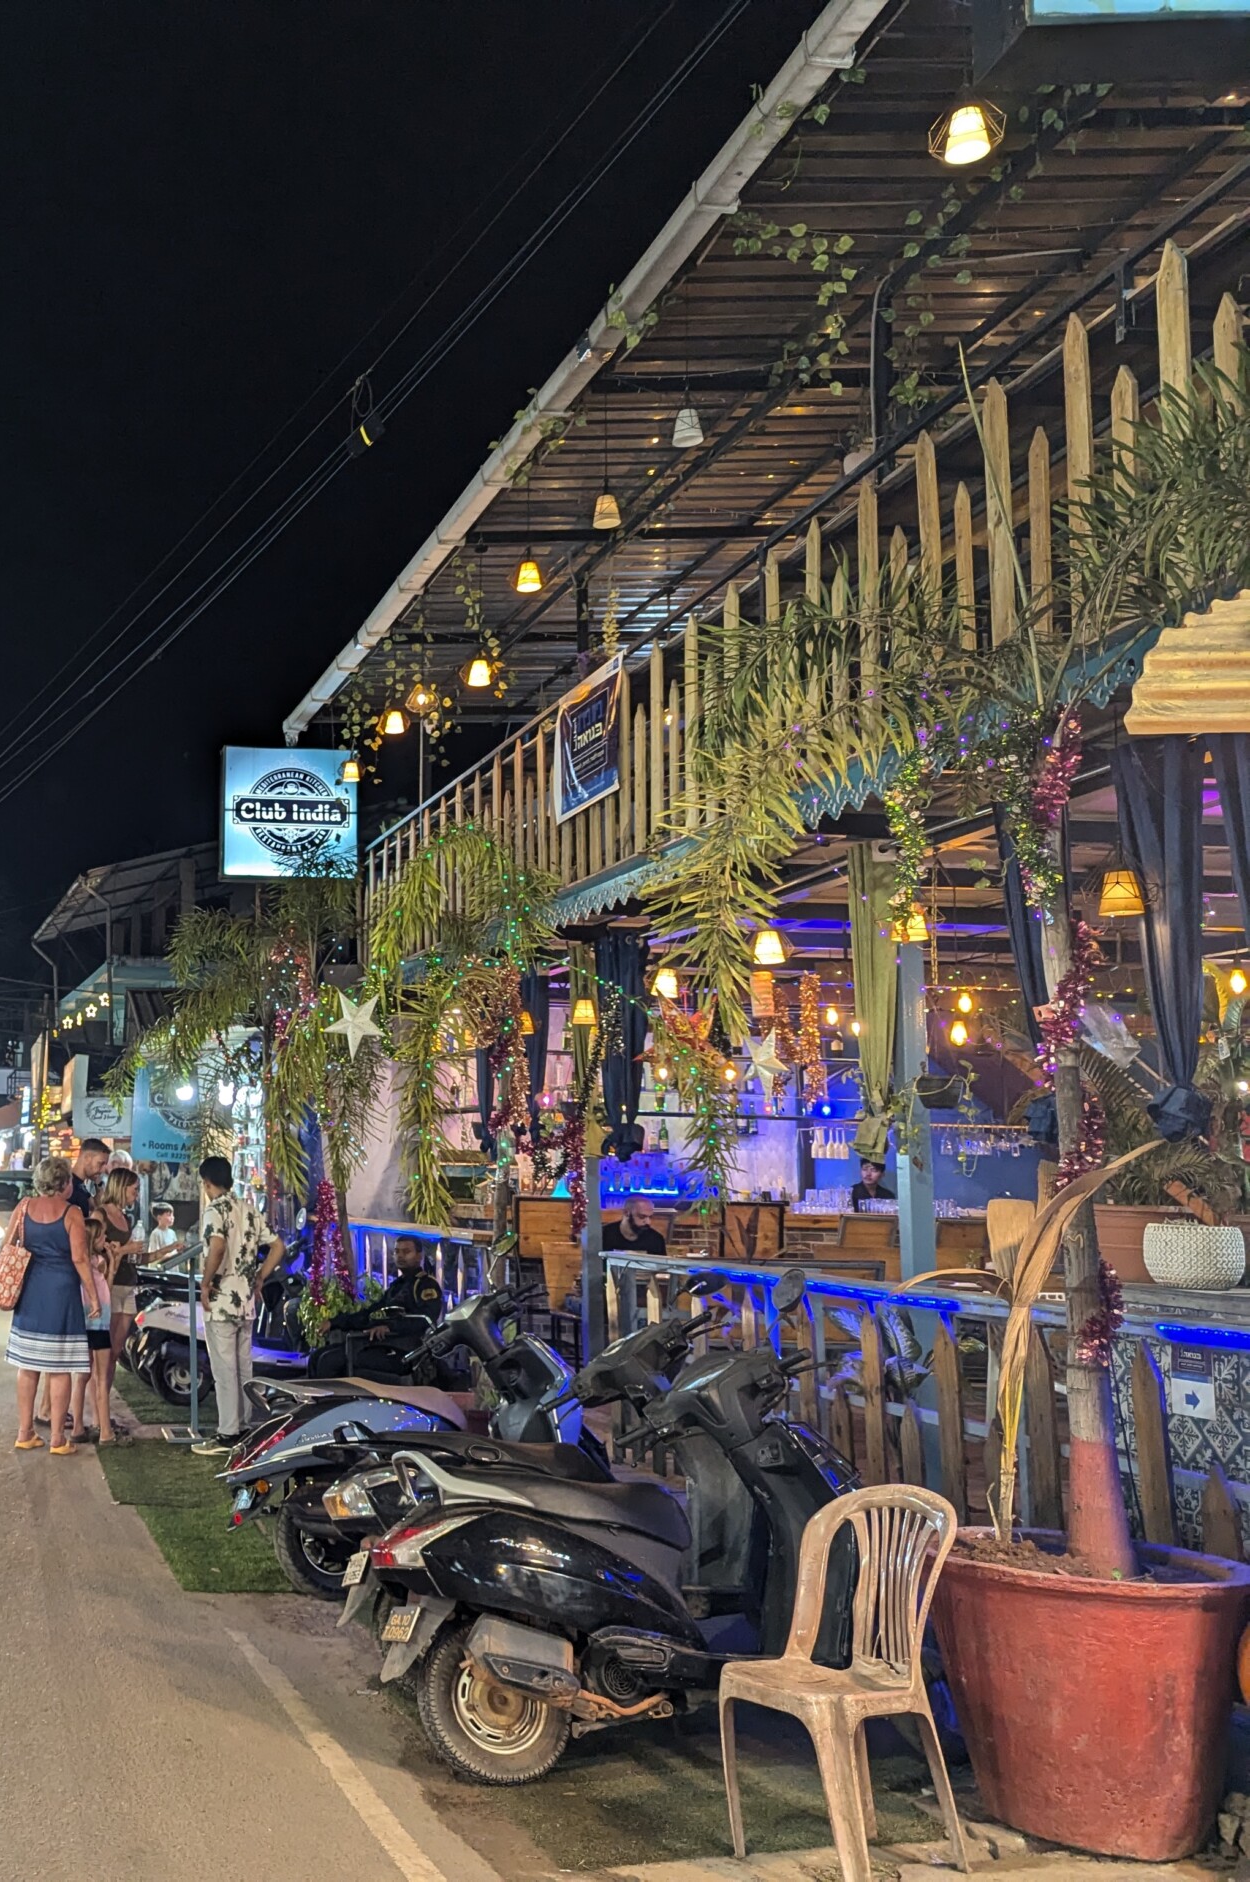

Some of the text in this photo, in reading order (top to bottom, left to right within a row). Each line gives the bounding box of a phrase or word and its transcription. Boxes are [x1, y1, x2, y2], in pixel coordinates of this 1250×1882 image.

[255, 772, 328, 796] MEDITERRANEAN KITCHEN
[240, 802, 342, 821] Club India
[255, 828, 302, 852] RESTAURANT
[148, 1140, 179, 1151] Rooms
